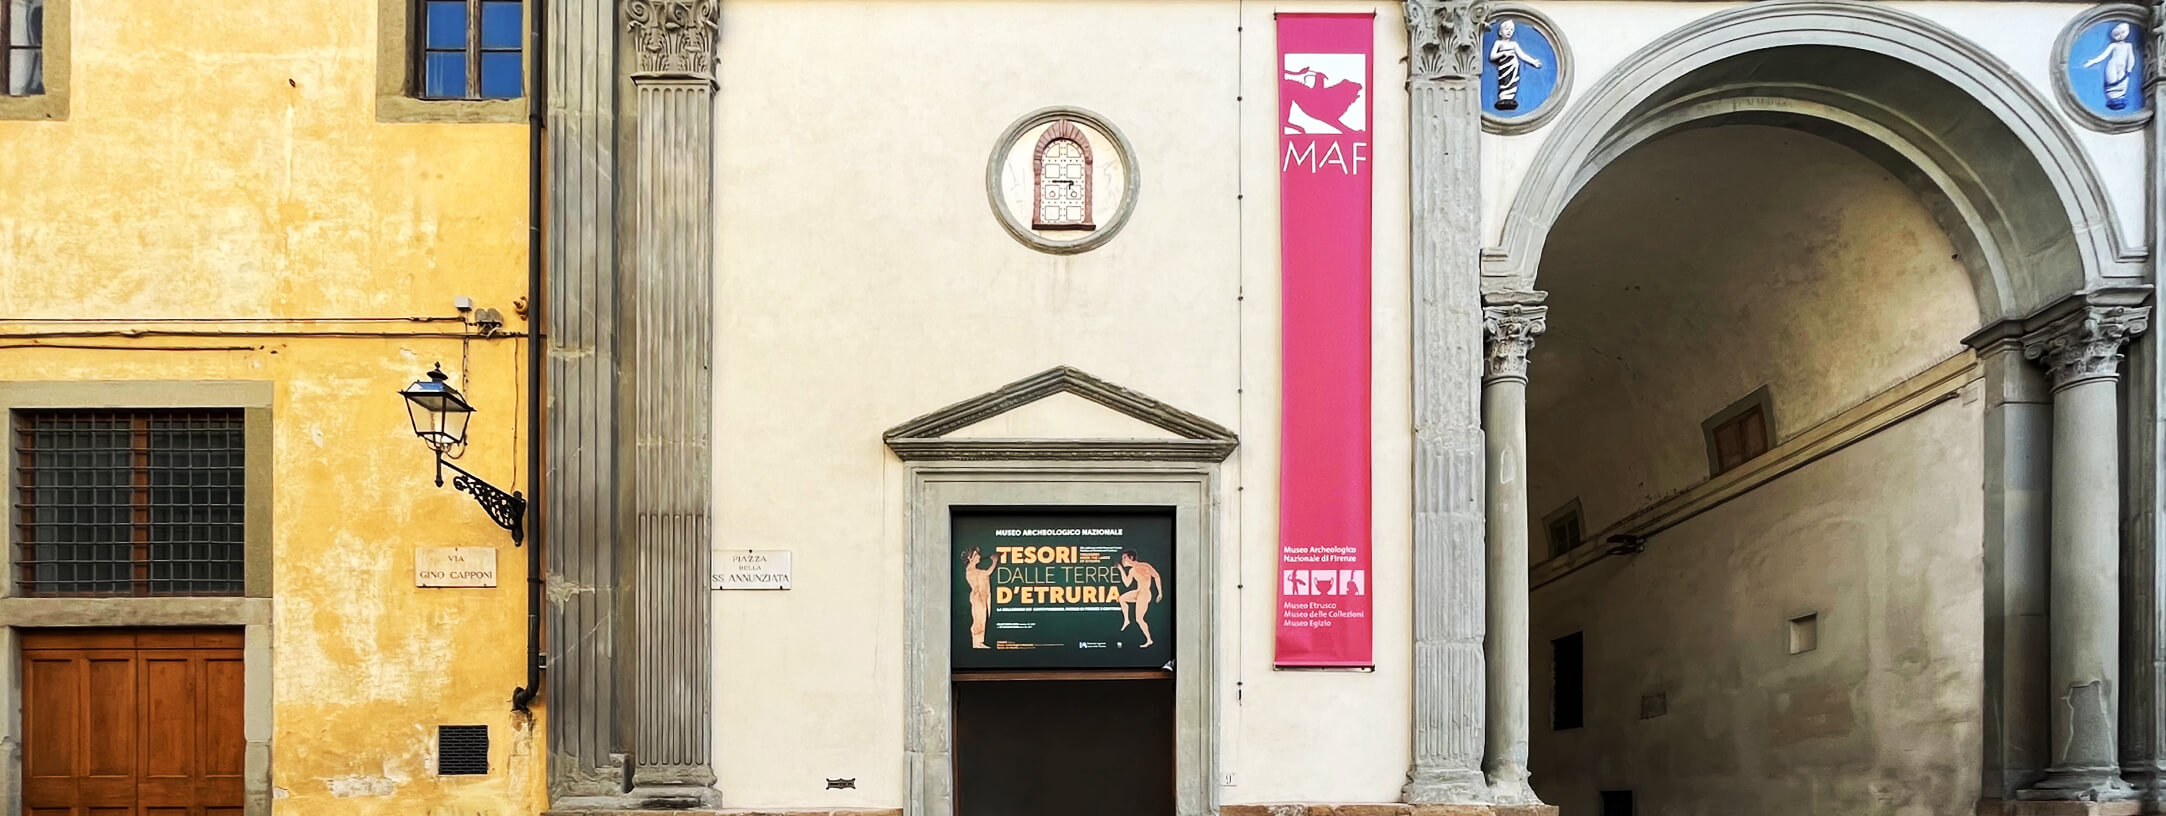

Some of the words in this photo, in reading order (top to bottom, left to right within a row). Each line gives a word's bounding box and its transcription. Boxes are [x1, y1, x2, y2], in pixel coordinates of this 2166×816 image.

[1283, 140, 1367, 175] MAF
[995, 529, 1021, 537] MUSEO
[1022, 529, 1081, 537] ARCHEOLOGICO
[1082, 528, 1123, 536] NAZIONALE
[995, 546, 1078, 564] TESORI
[1283, 546, 1308, 554] Museo
[1309, 546, 1357, 555] Archeologico
[419, 571, 445, 579] GINO
[449, 571, 493, 579] CAPPONI
[712, 574, 725, 582] SS
[728, 574, 790, 582] ANNUNZIATA
[997, 567, 1056, 584] DALLE
[1060, 566, 1121, 583] TERRE
[1283, 601, 1308, 609] Museo
[1283, 610, 1308, 618] Museo
[1309, 610, 1327, 618] delle
[1328, 610, 1365, 618] Collezioni
[1283, 619, 1308, 627] Museo
[1309, 619, 1332, 629] Egizio
